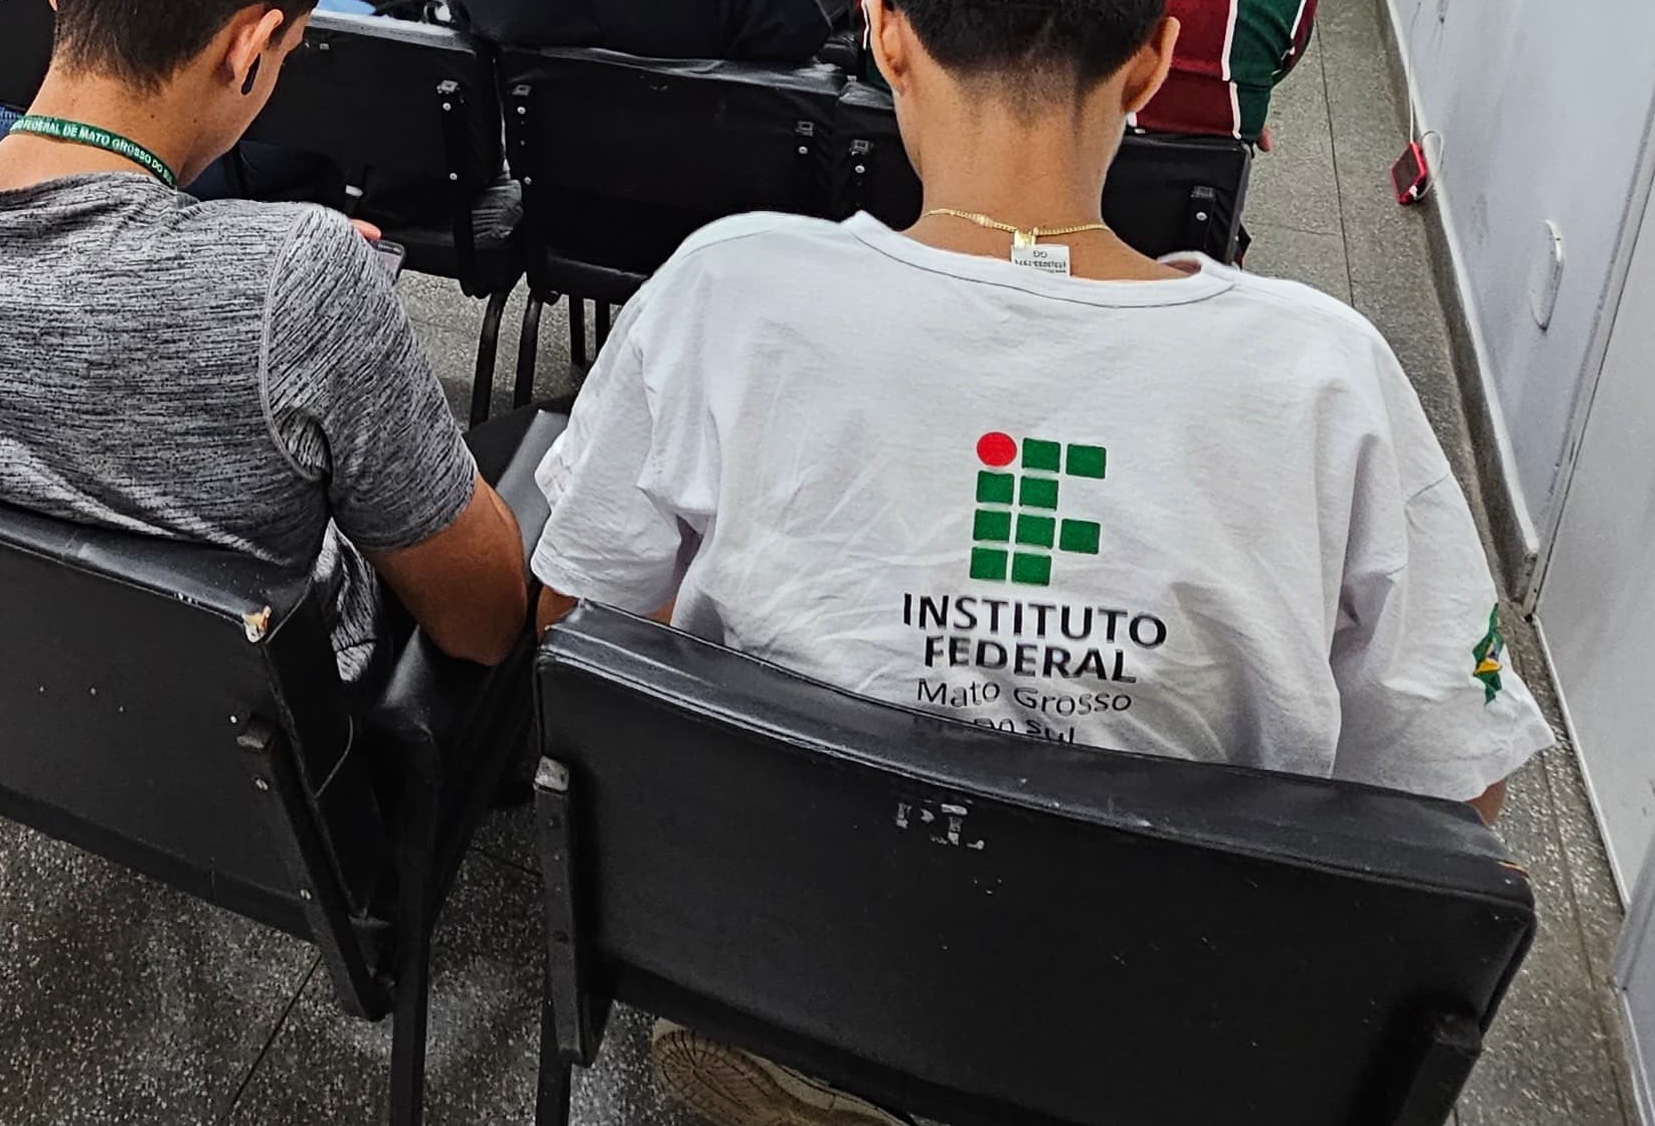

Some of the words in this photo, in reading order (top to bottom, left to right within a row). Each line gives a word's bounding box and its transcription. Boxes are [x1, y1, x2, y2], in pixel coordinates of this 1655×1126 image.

[63, 123, 79, 137] DE
[78, 126, 111, 147] MATO
[112, 138, 151, 164] GROSSO
[151, 158, 164, 174] DO
[903, 593, 1167, 649] INSTITUTO
[923, 634, 1137, 685] FEDERAL
[916, 677, 1001, 708] Mato
[1013, 686, 1133, 717] Grosso
